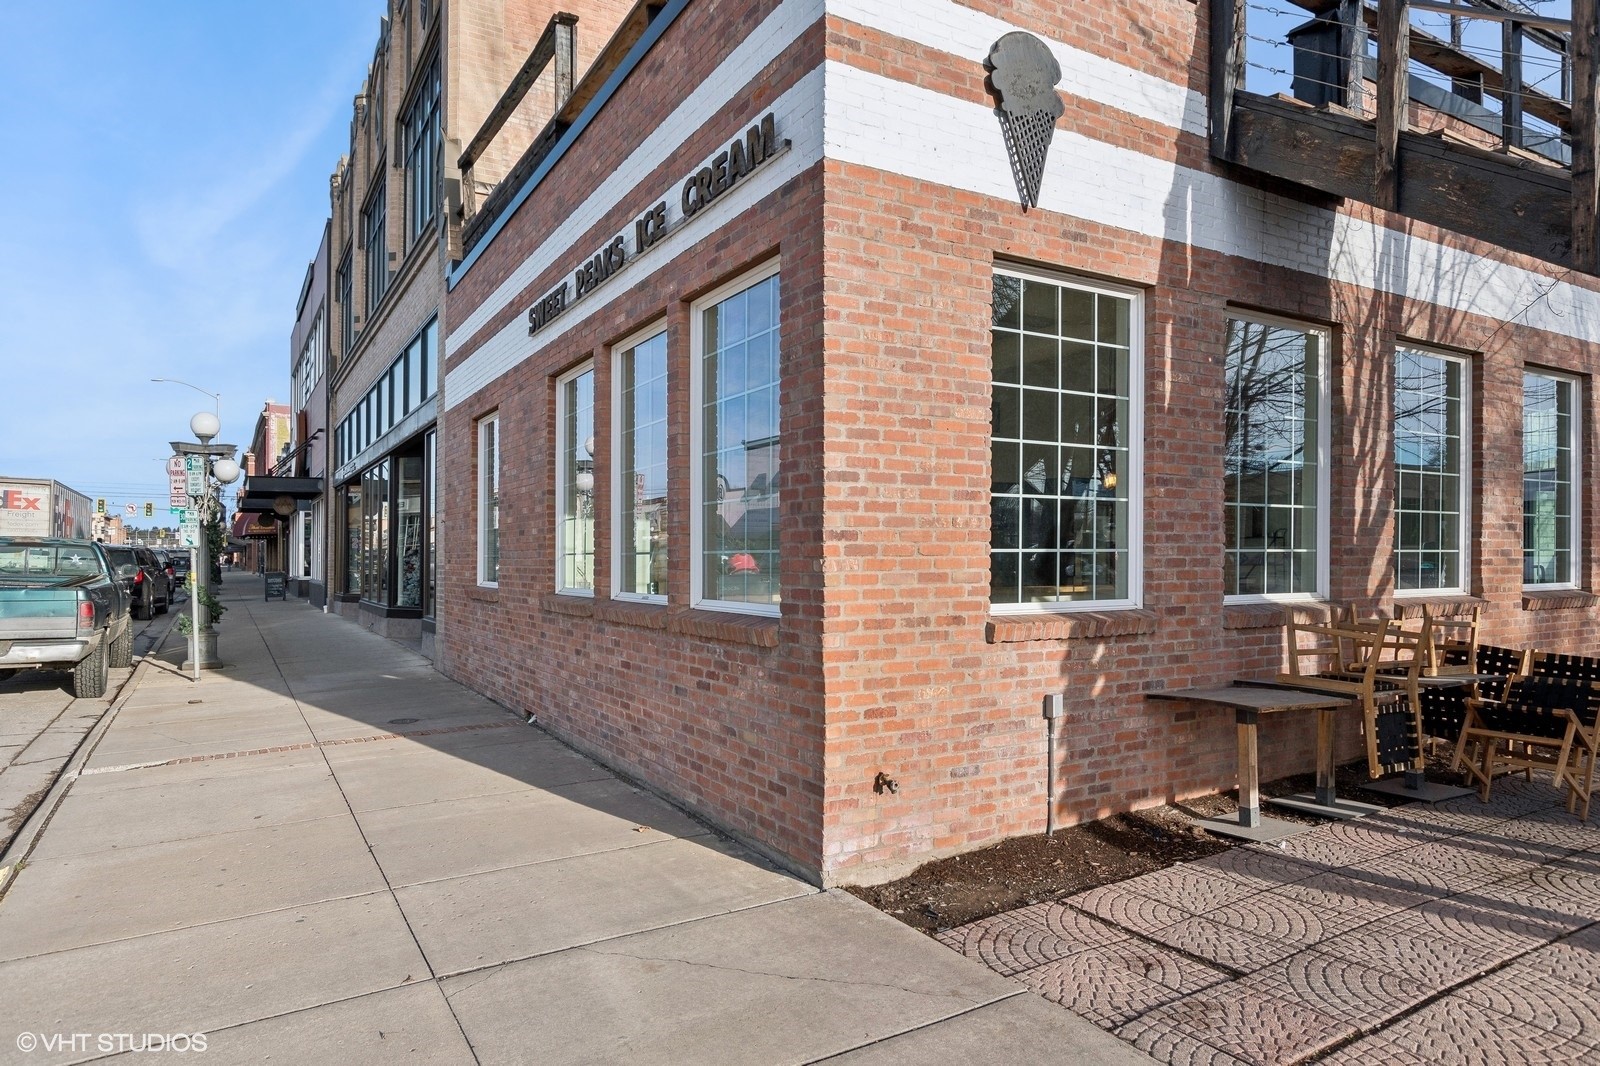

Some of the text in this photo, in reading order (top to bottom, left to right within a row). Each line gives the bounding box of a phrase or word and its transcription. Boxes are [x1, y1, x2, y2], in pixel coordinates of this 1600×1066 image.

[528, 281, 568, 336] SWEET
[575, 235, 625, 300] PEAKS
[635, 200, 667, 254] ICE
[173, 460, 182, 468] NO
[7, 511, 35, 519] Freight
